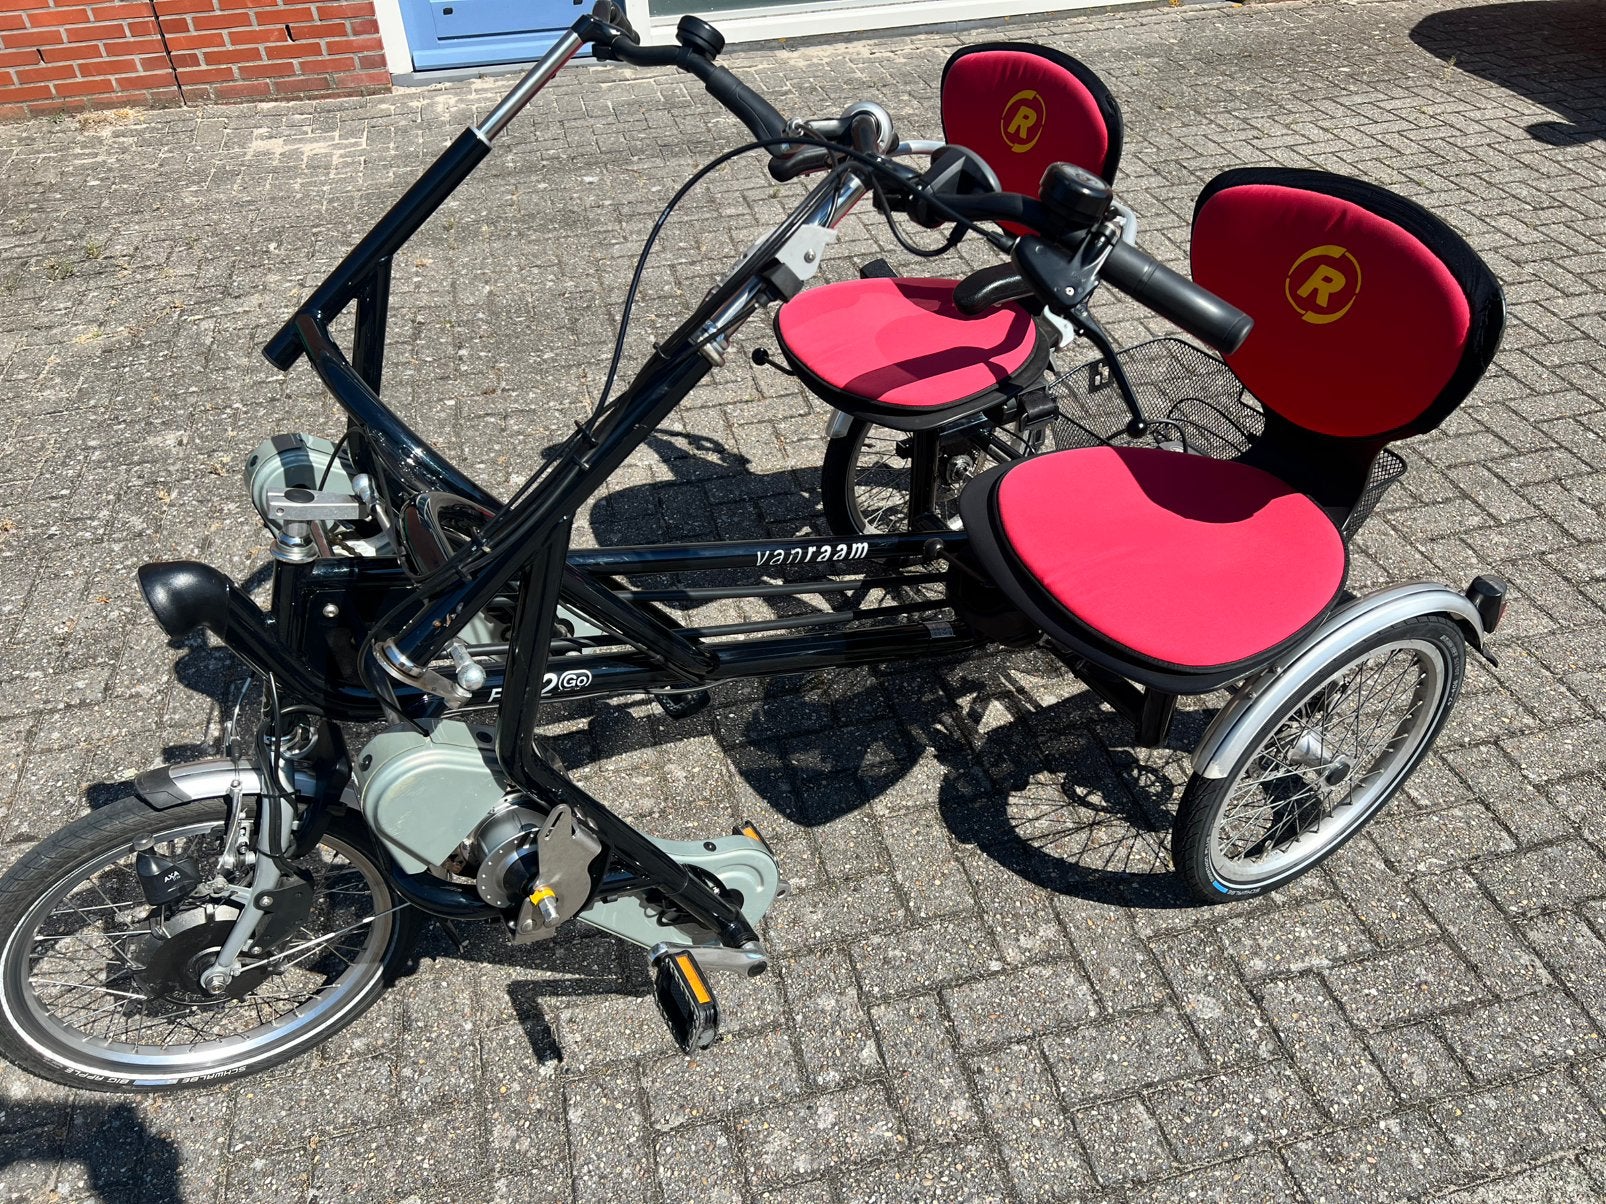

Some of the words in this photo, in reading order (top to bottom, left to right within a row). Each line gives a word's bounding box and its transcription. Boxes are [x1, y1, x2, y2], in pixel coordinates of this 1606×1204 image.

[1007, 105, 1037, 139] R
[1296, 264, 1346, 308] R
[756, 542, 869, 566] vanraam
[64, 1067, 105, 1082] APPLE
[106, 1076, 130, 1085] BIG
[181, 1065, 247, 1084] SCHWALBE
